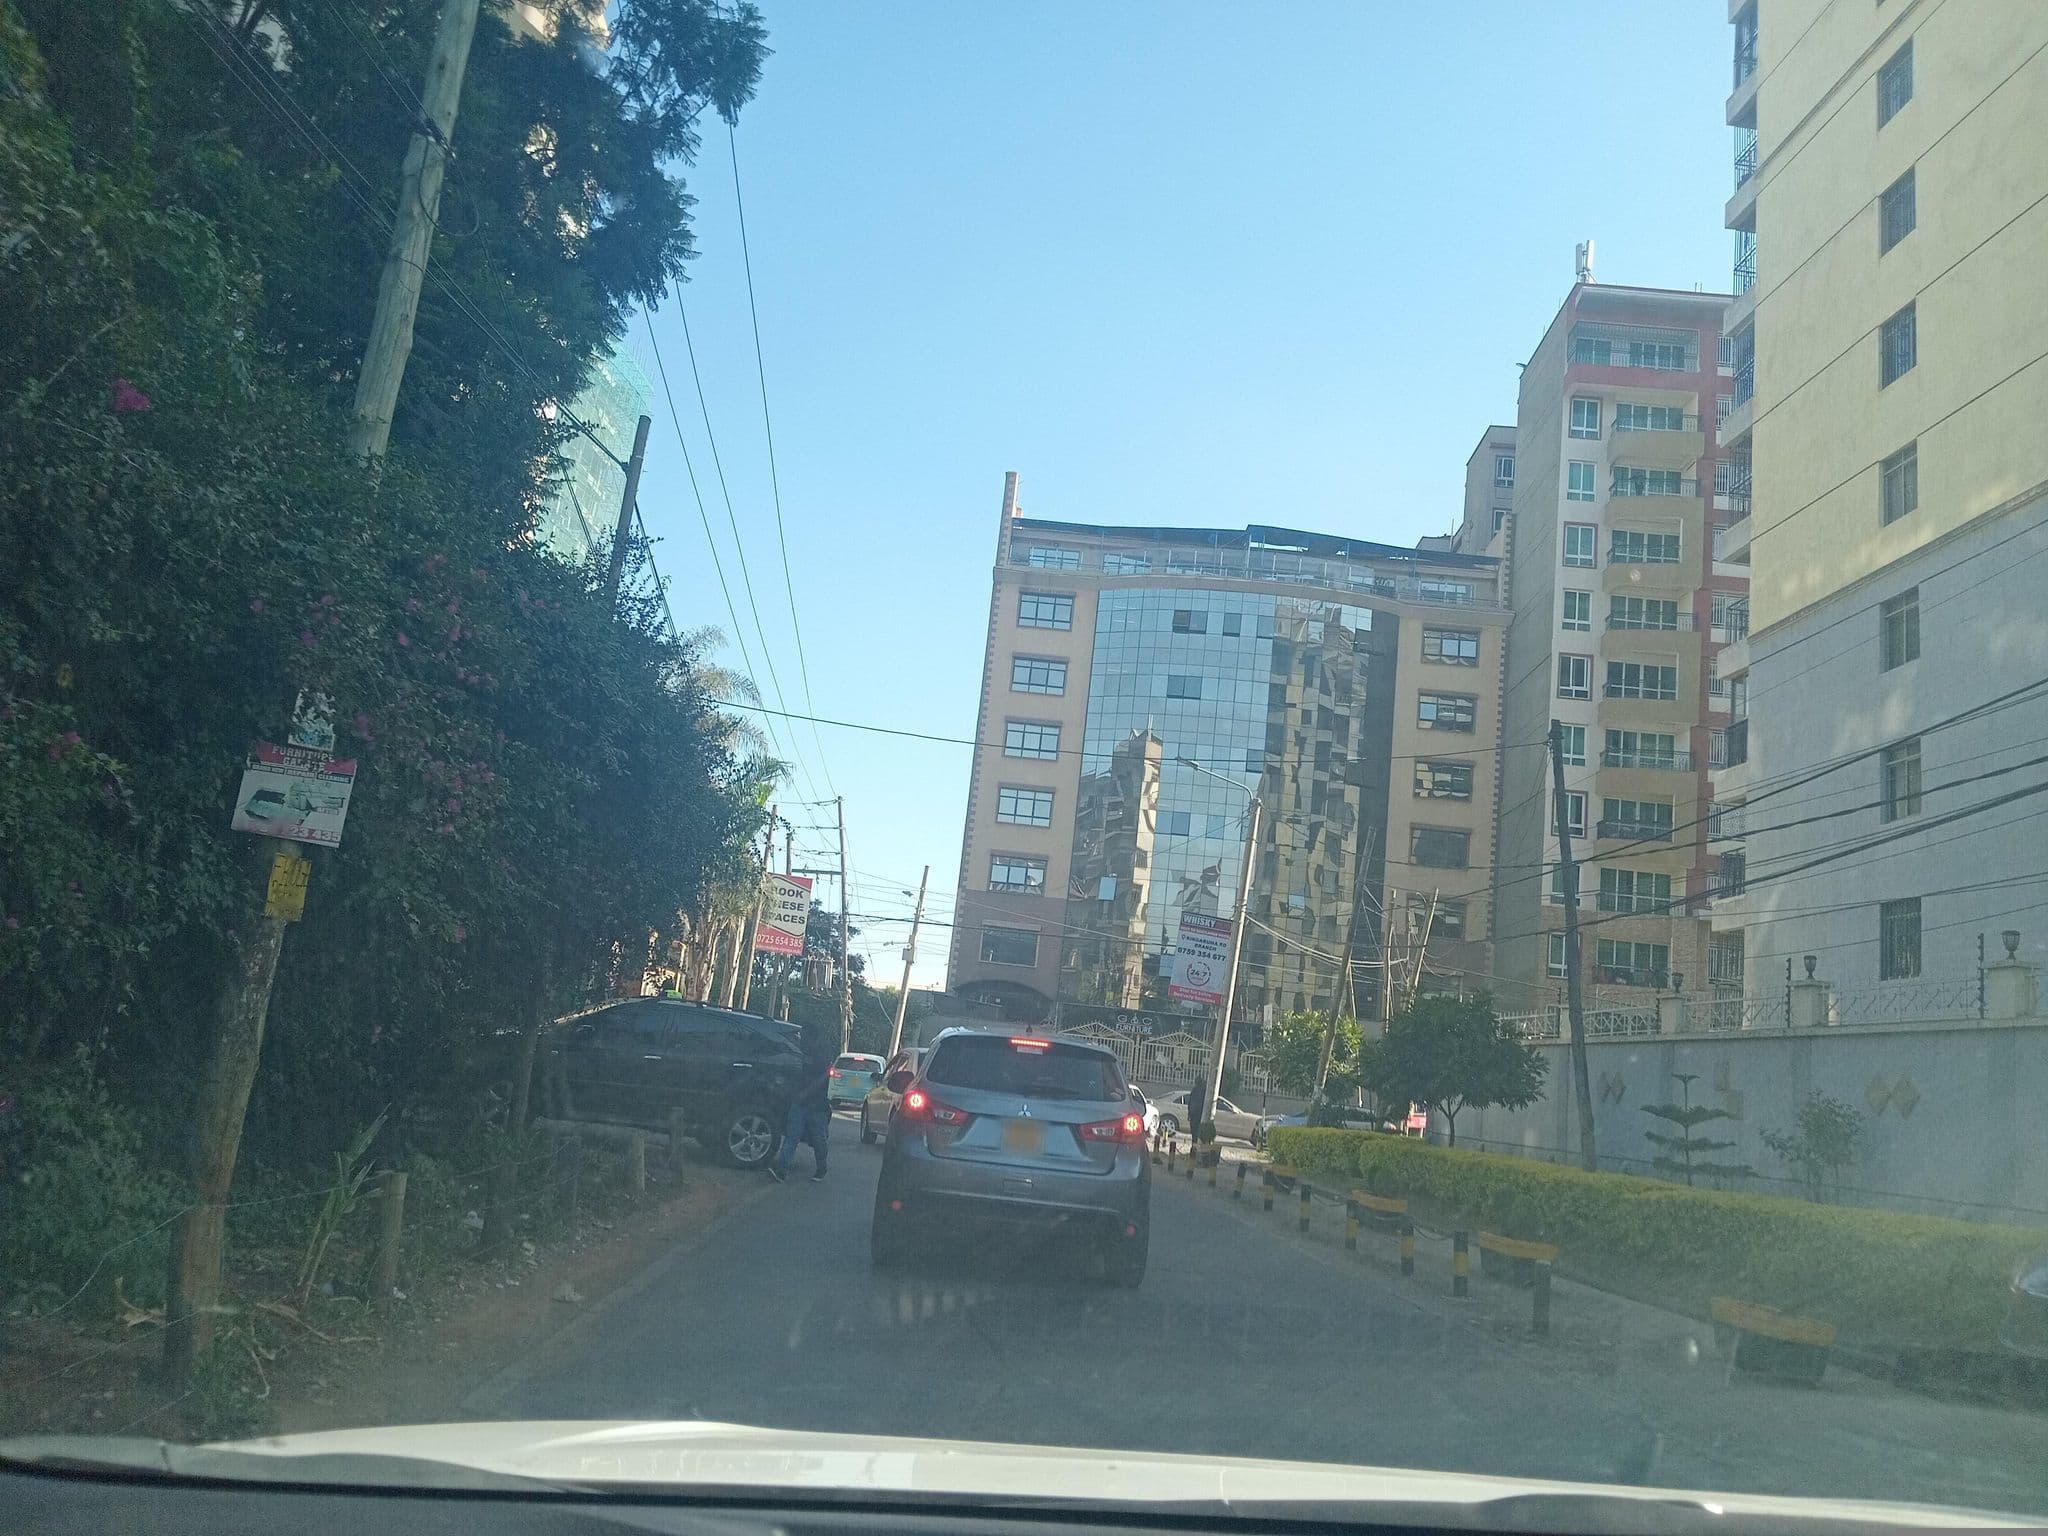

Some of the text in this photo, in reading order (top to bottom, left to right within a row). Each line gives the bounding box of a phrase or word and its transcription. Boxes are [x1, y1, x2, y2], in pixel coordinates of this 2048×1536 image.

[774, 887, 804, 899] OOK
[774, 900, 805, 912] ESE
[769, 912, 806, 925] ACES
[1183, 914, 1217, 928] WHISKY
[756, 935, 775, 945] 0725
[775, 936, 789, 946] 654
[1116, 1023, 1153, 1034] FURNITURE
